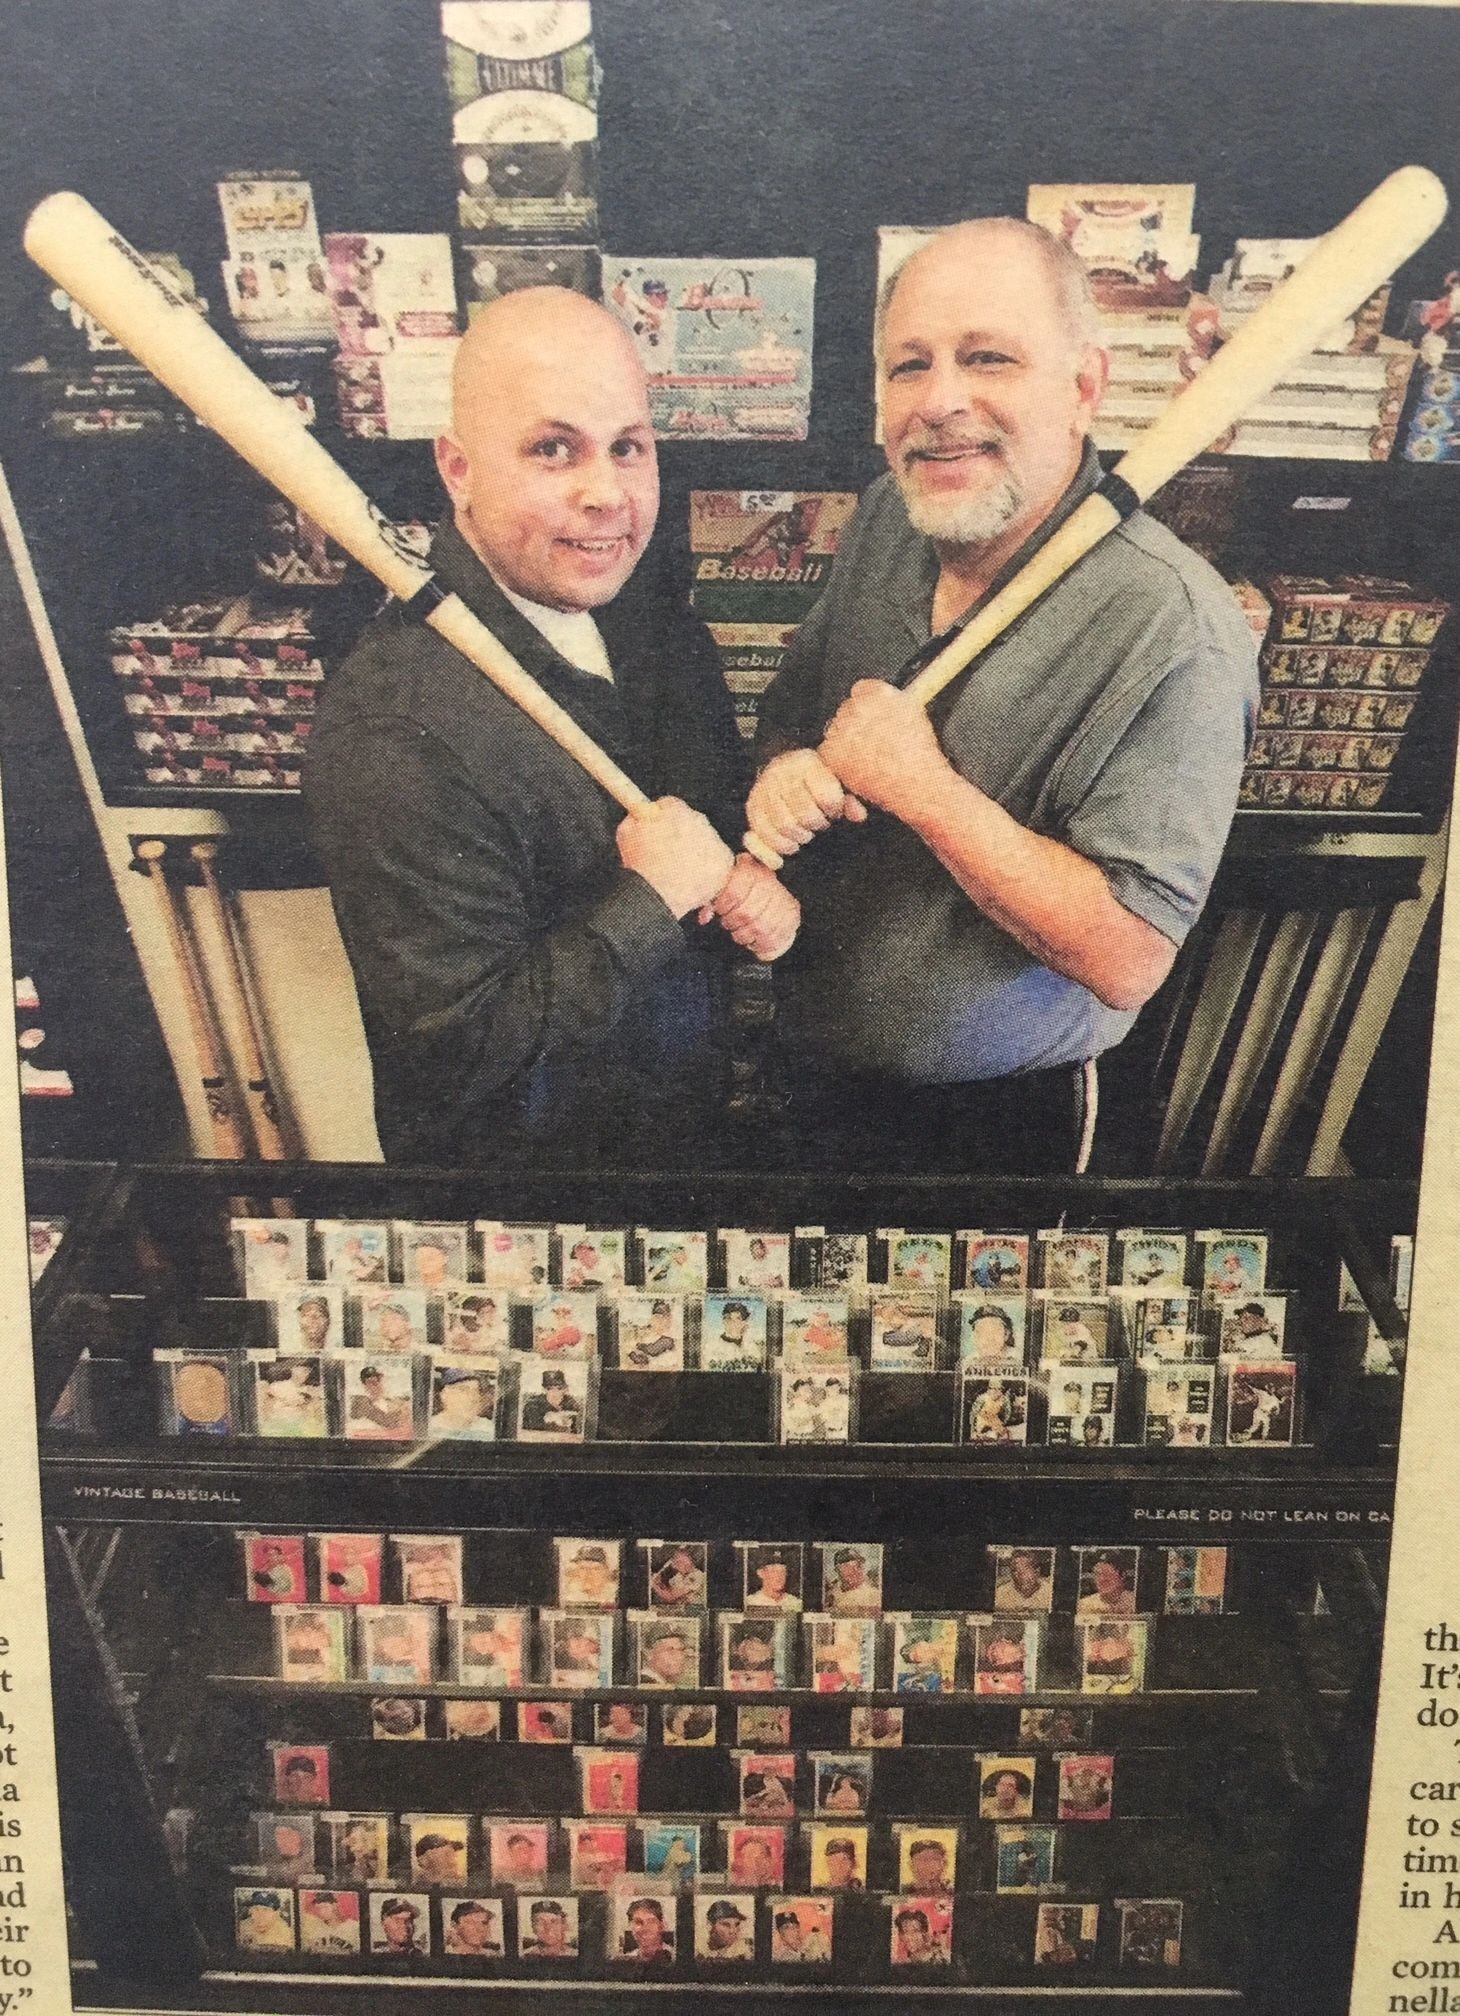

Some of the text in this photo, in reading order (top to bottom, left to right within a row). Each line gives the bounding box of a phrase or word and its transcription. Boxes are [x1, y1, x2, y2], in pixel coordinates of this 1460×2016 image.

[74, 1487, 241, 1502] VINTAGE BASEBALL
[1134, 1508, 1200, 1521] PLEASE
[1208, 1510, 1233, 1521] DO
[1241, 1509, 1278, 1521] NOT
[1284, 1510, 1328, 1522] LEAN
[1335, 1511, 1361, 1522] ON
[1399, 1882, 1431, 1908] in
